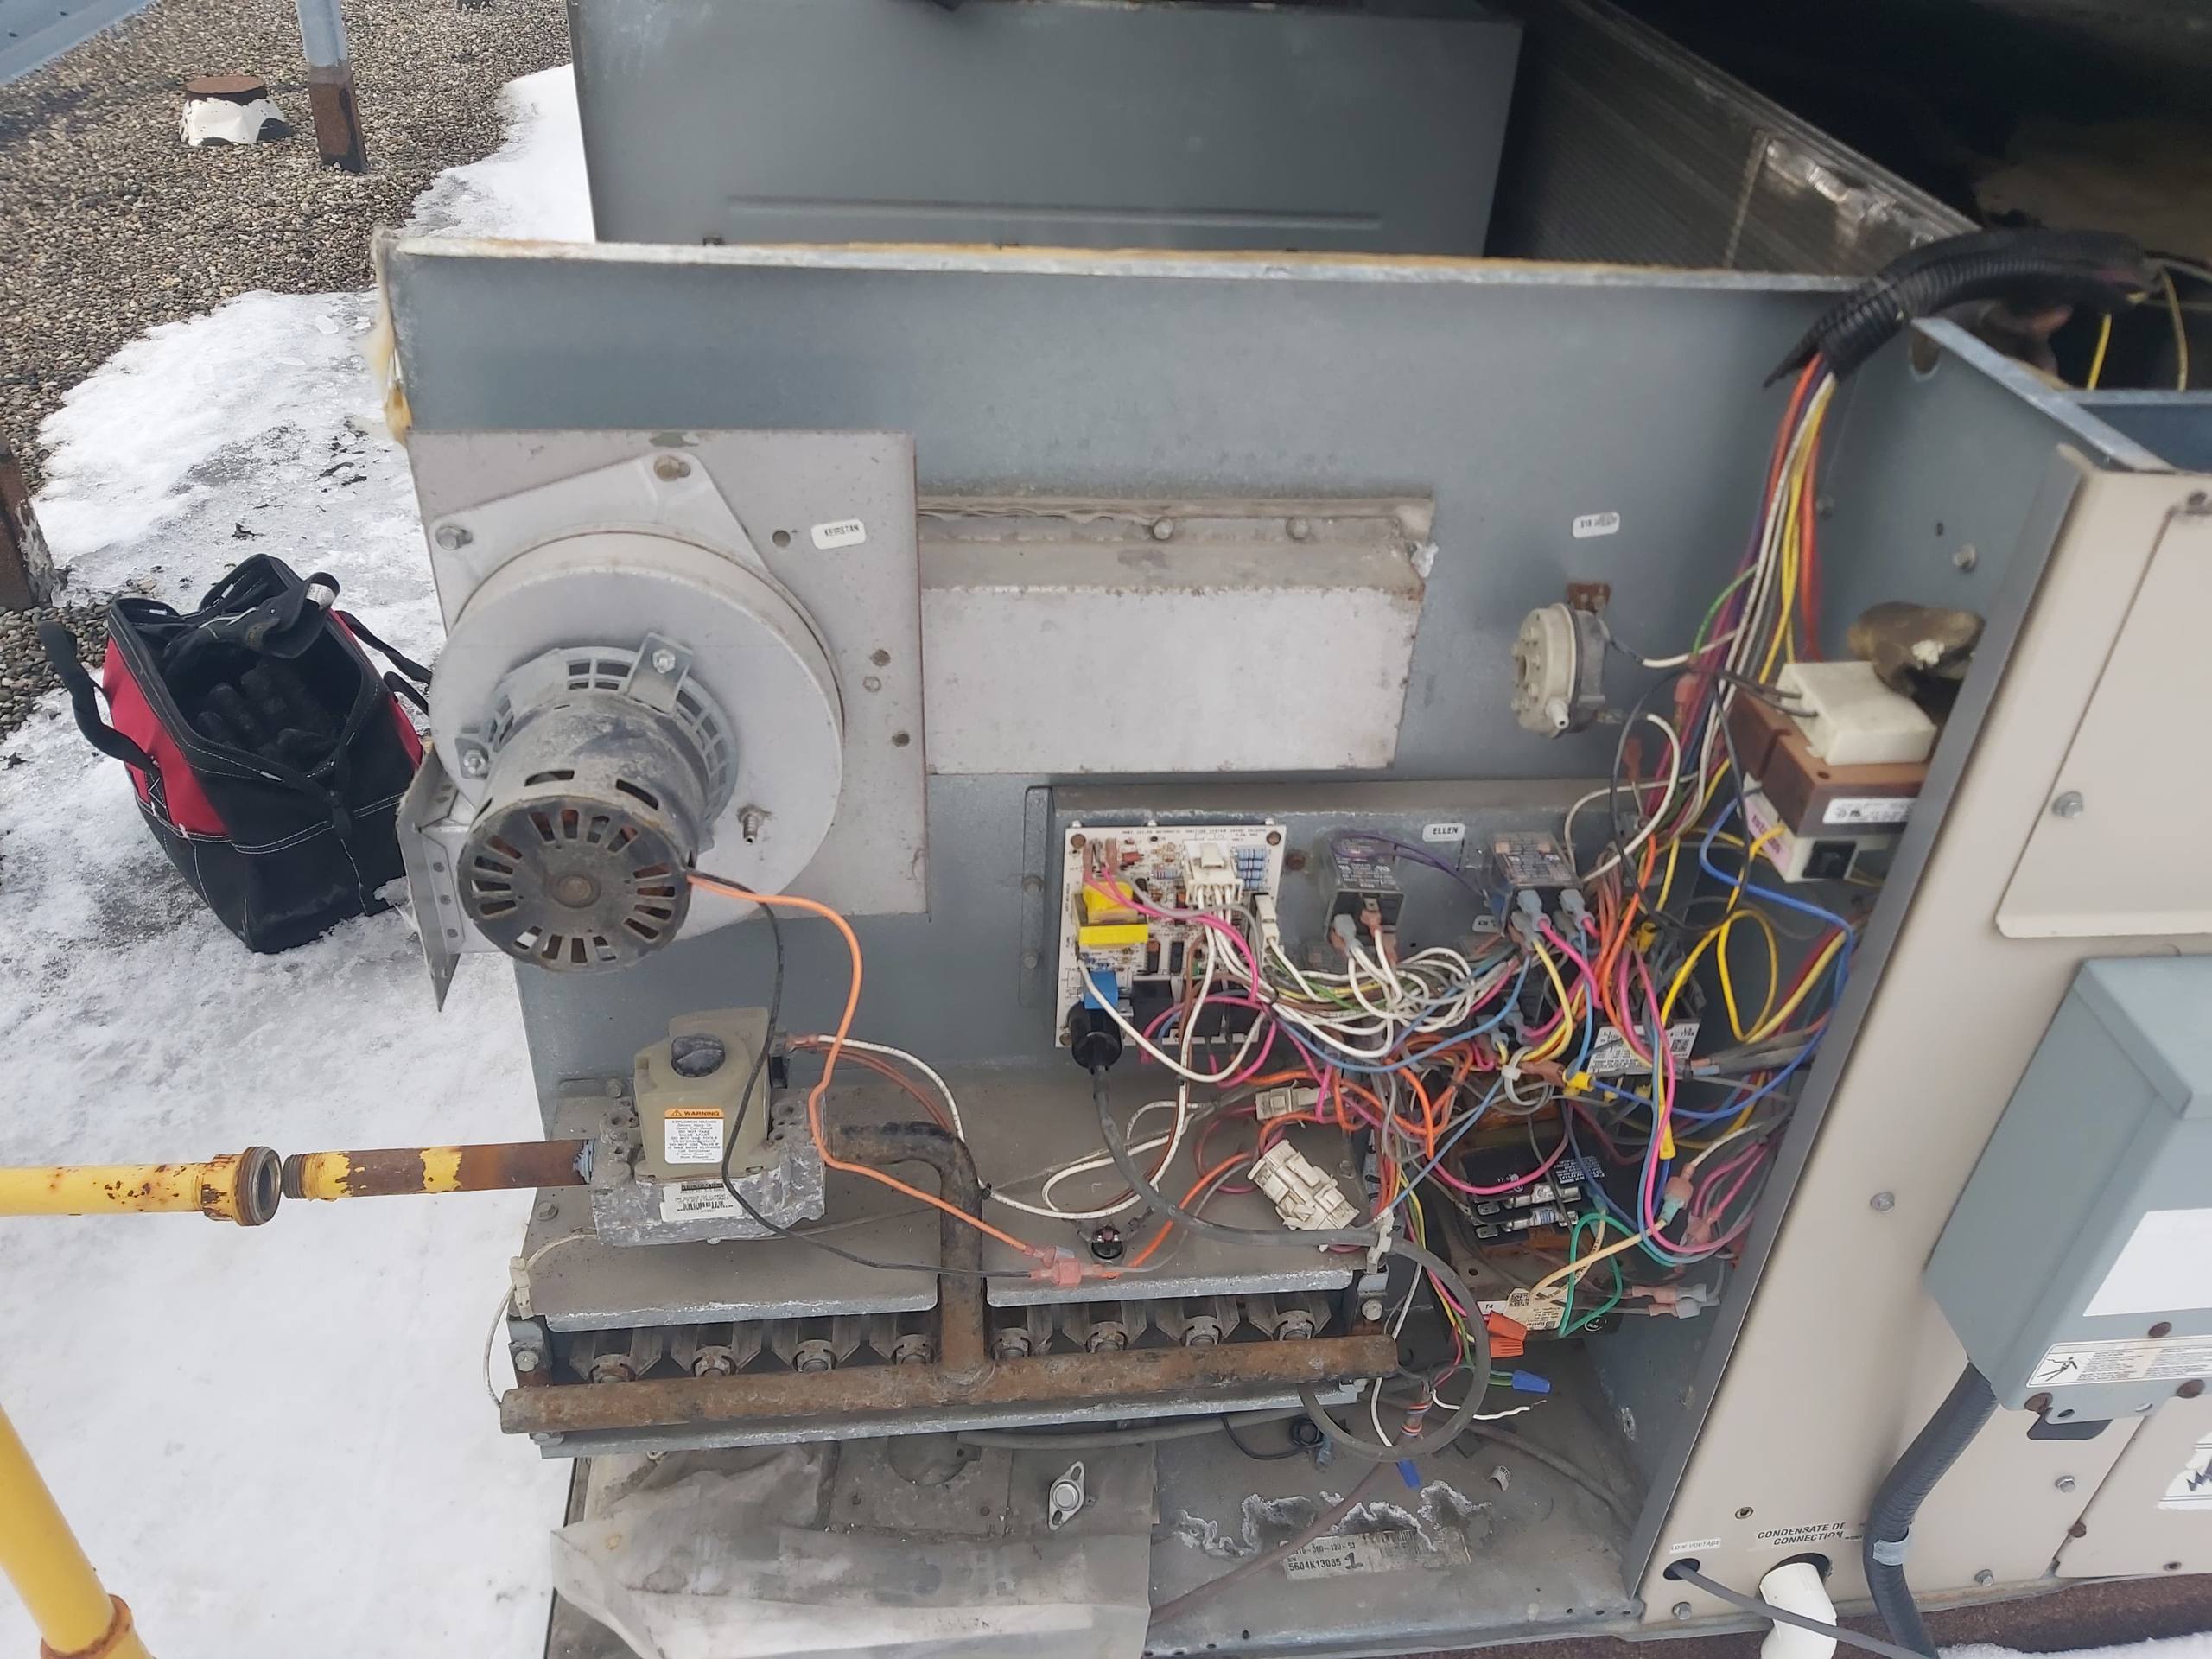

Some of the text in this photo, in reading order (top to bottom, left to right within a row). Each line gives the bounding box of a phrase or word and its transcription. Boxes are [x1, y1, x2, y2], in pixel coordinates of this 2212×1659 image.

[1433, 826, 1459, 835] ELLEN
[1758, 1523, 1830, 1539] CONDENSATE
[1773, 1531, 1844, 1545] CONNECTION
